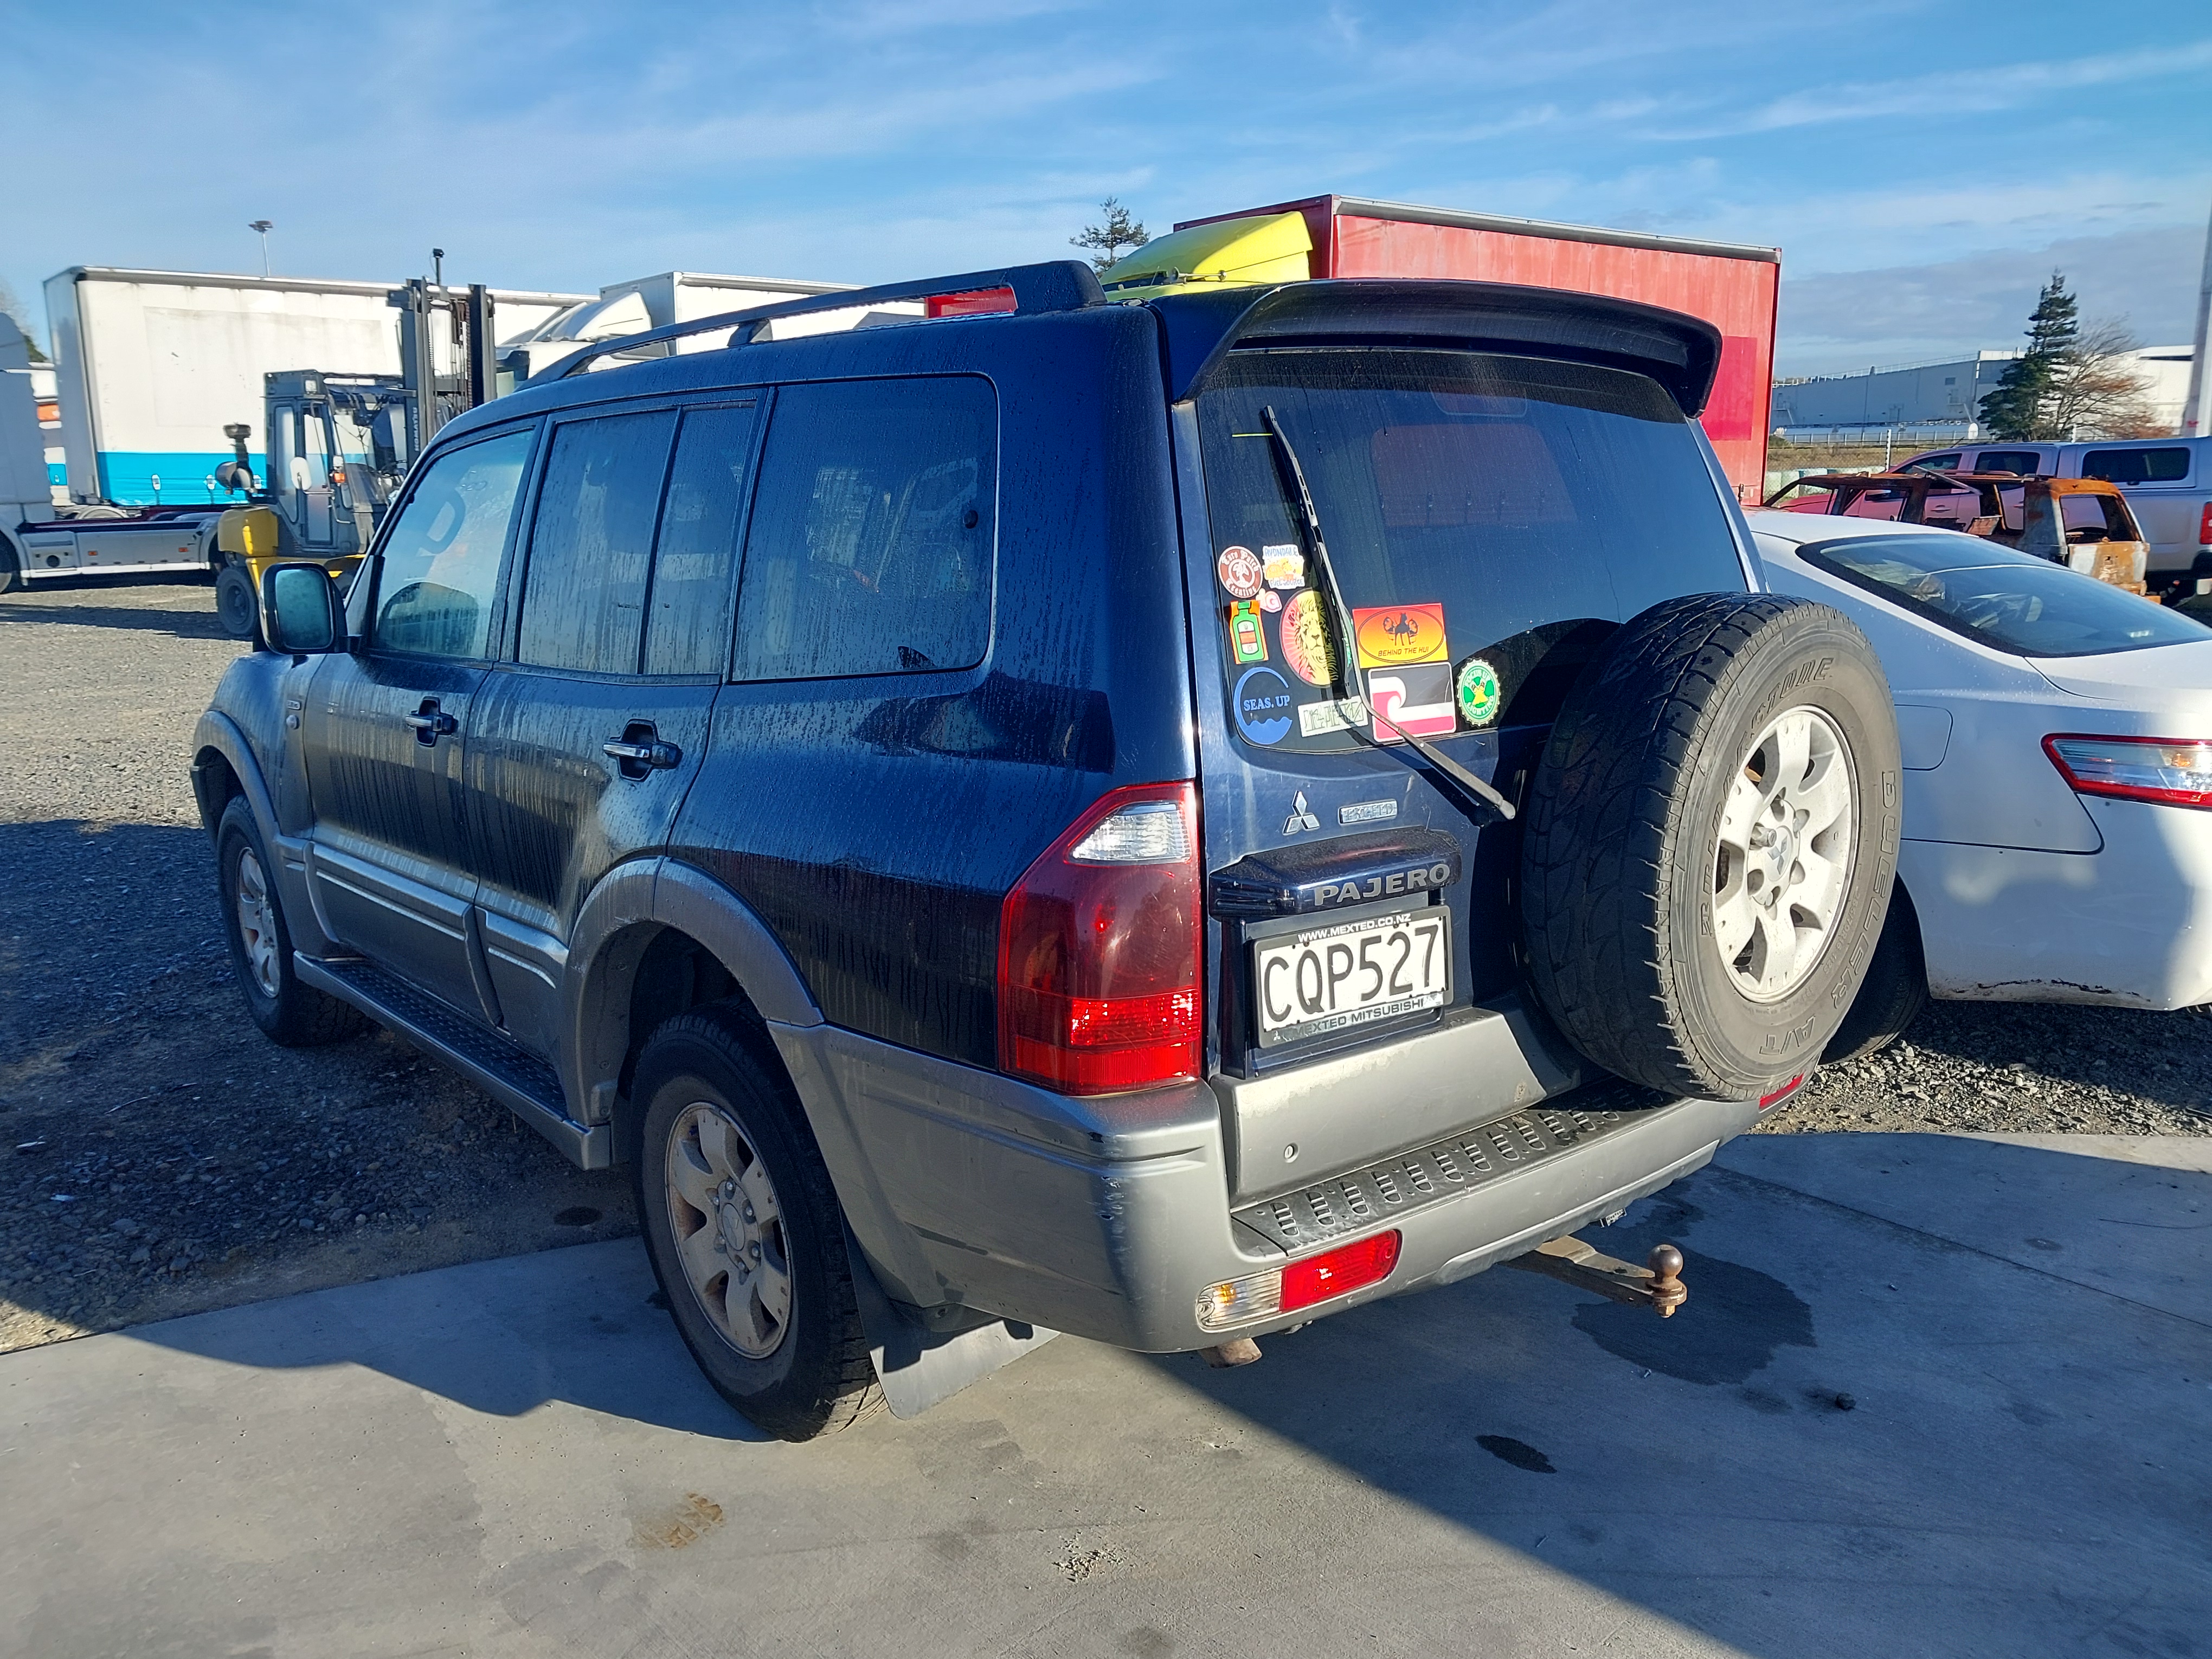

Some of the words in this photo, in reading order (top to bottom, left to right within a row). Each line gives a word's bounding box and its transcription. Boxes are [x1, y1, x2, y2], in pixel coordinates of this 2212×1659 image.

[1244, 698, 1274, 711] SEAS.
[1276, 696, 1290, 707] UP
[1466, 695, 1494, 716] LIGHTING
[1314, 864, 1450, 906] PAJERO
[1831, 770, 1896, 1009] DUELER
[1298, 913, 1411, 942] WWW.MEXTED.CO.NZ
[1264, 924, 1438, 1023] CQP527
[1351, 998, 1423, 1024] MITSUBISHI
[1759, 1015, 1816, 1055] A/T
